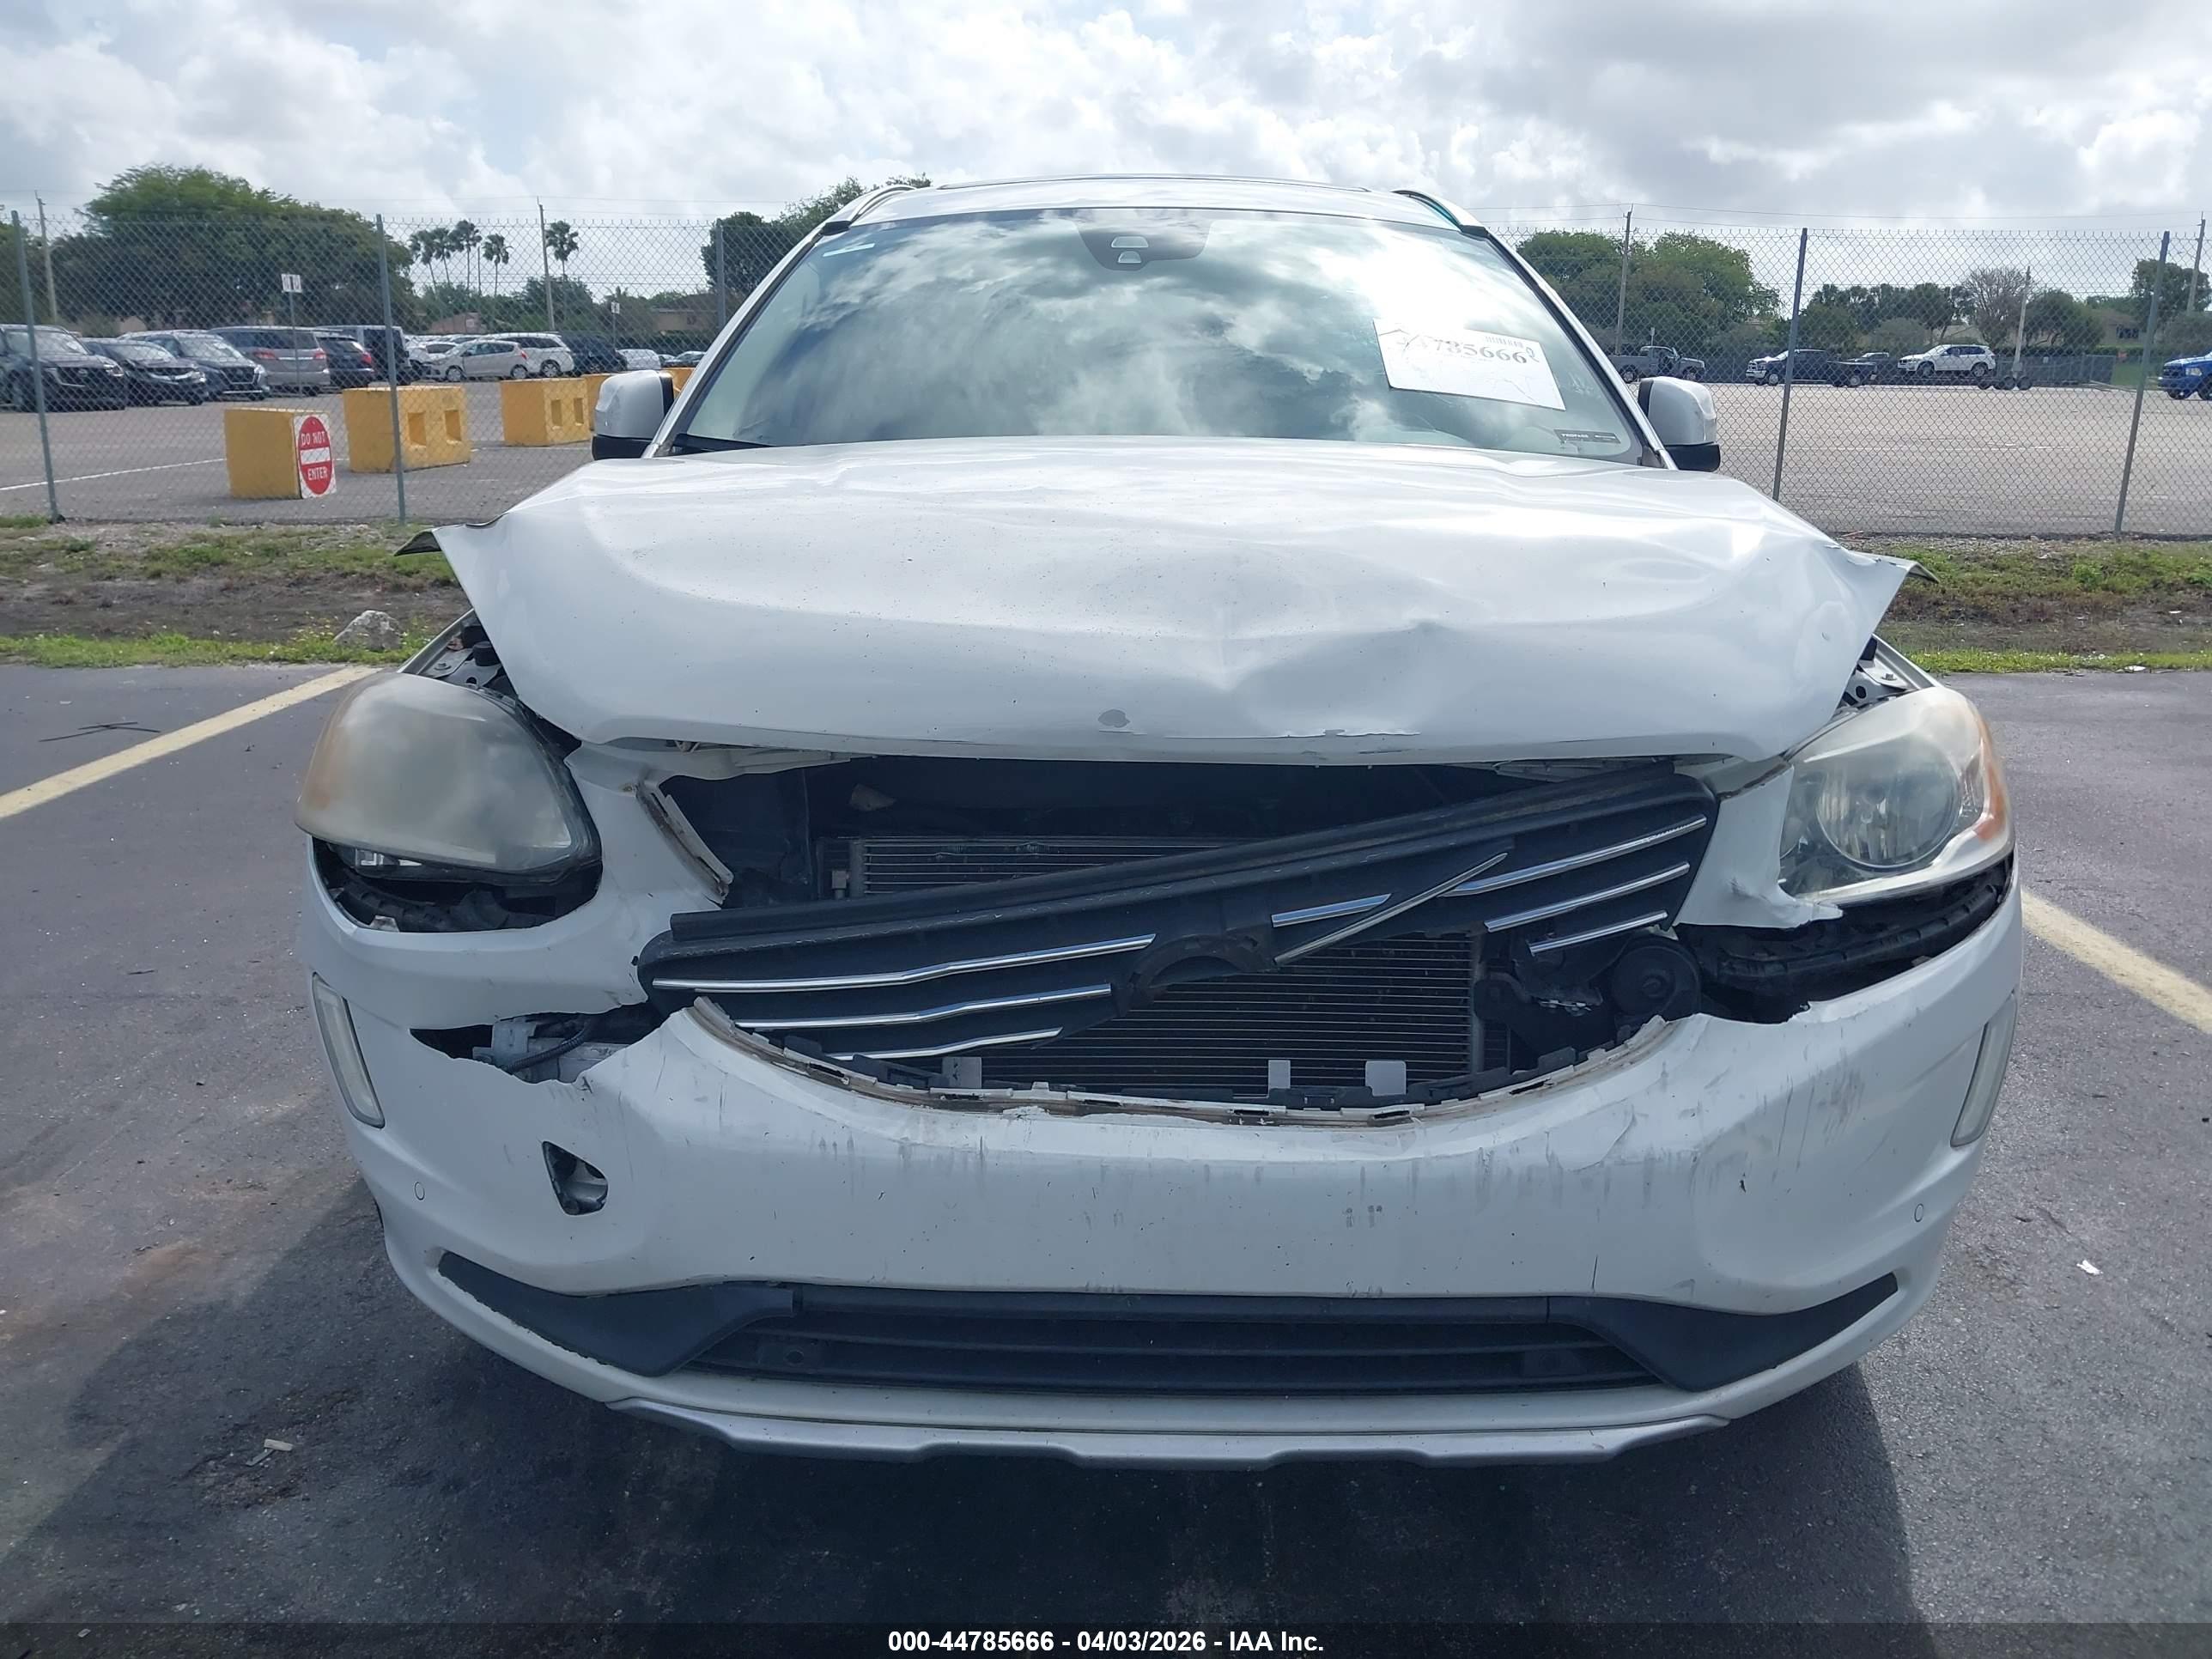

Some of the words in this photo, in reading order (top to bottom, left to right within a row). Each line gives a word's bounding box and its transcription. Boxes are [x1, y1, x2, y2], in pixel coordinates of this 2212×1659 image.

[1396, 337, 1528, 364] 785666
[301, 434, 311, 446] DO
[313, 431, 325, 444] NOT
[307, 466, 328, 480] ENTER
